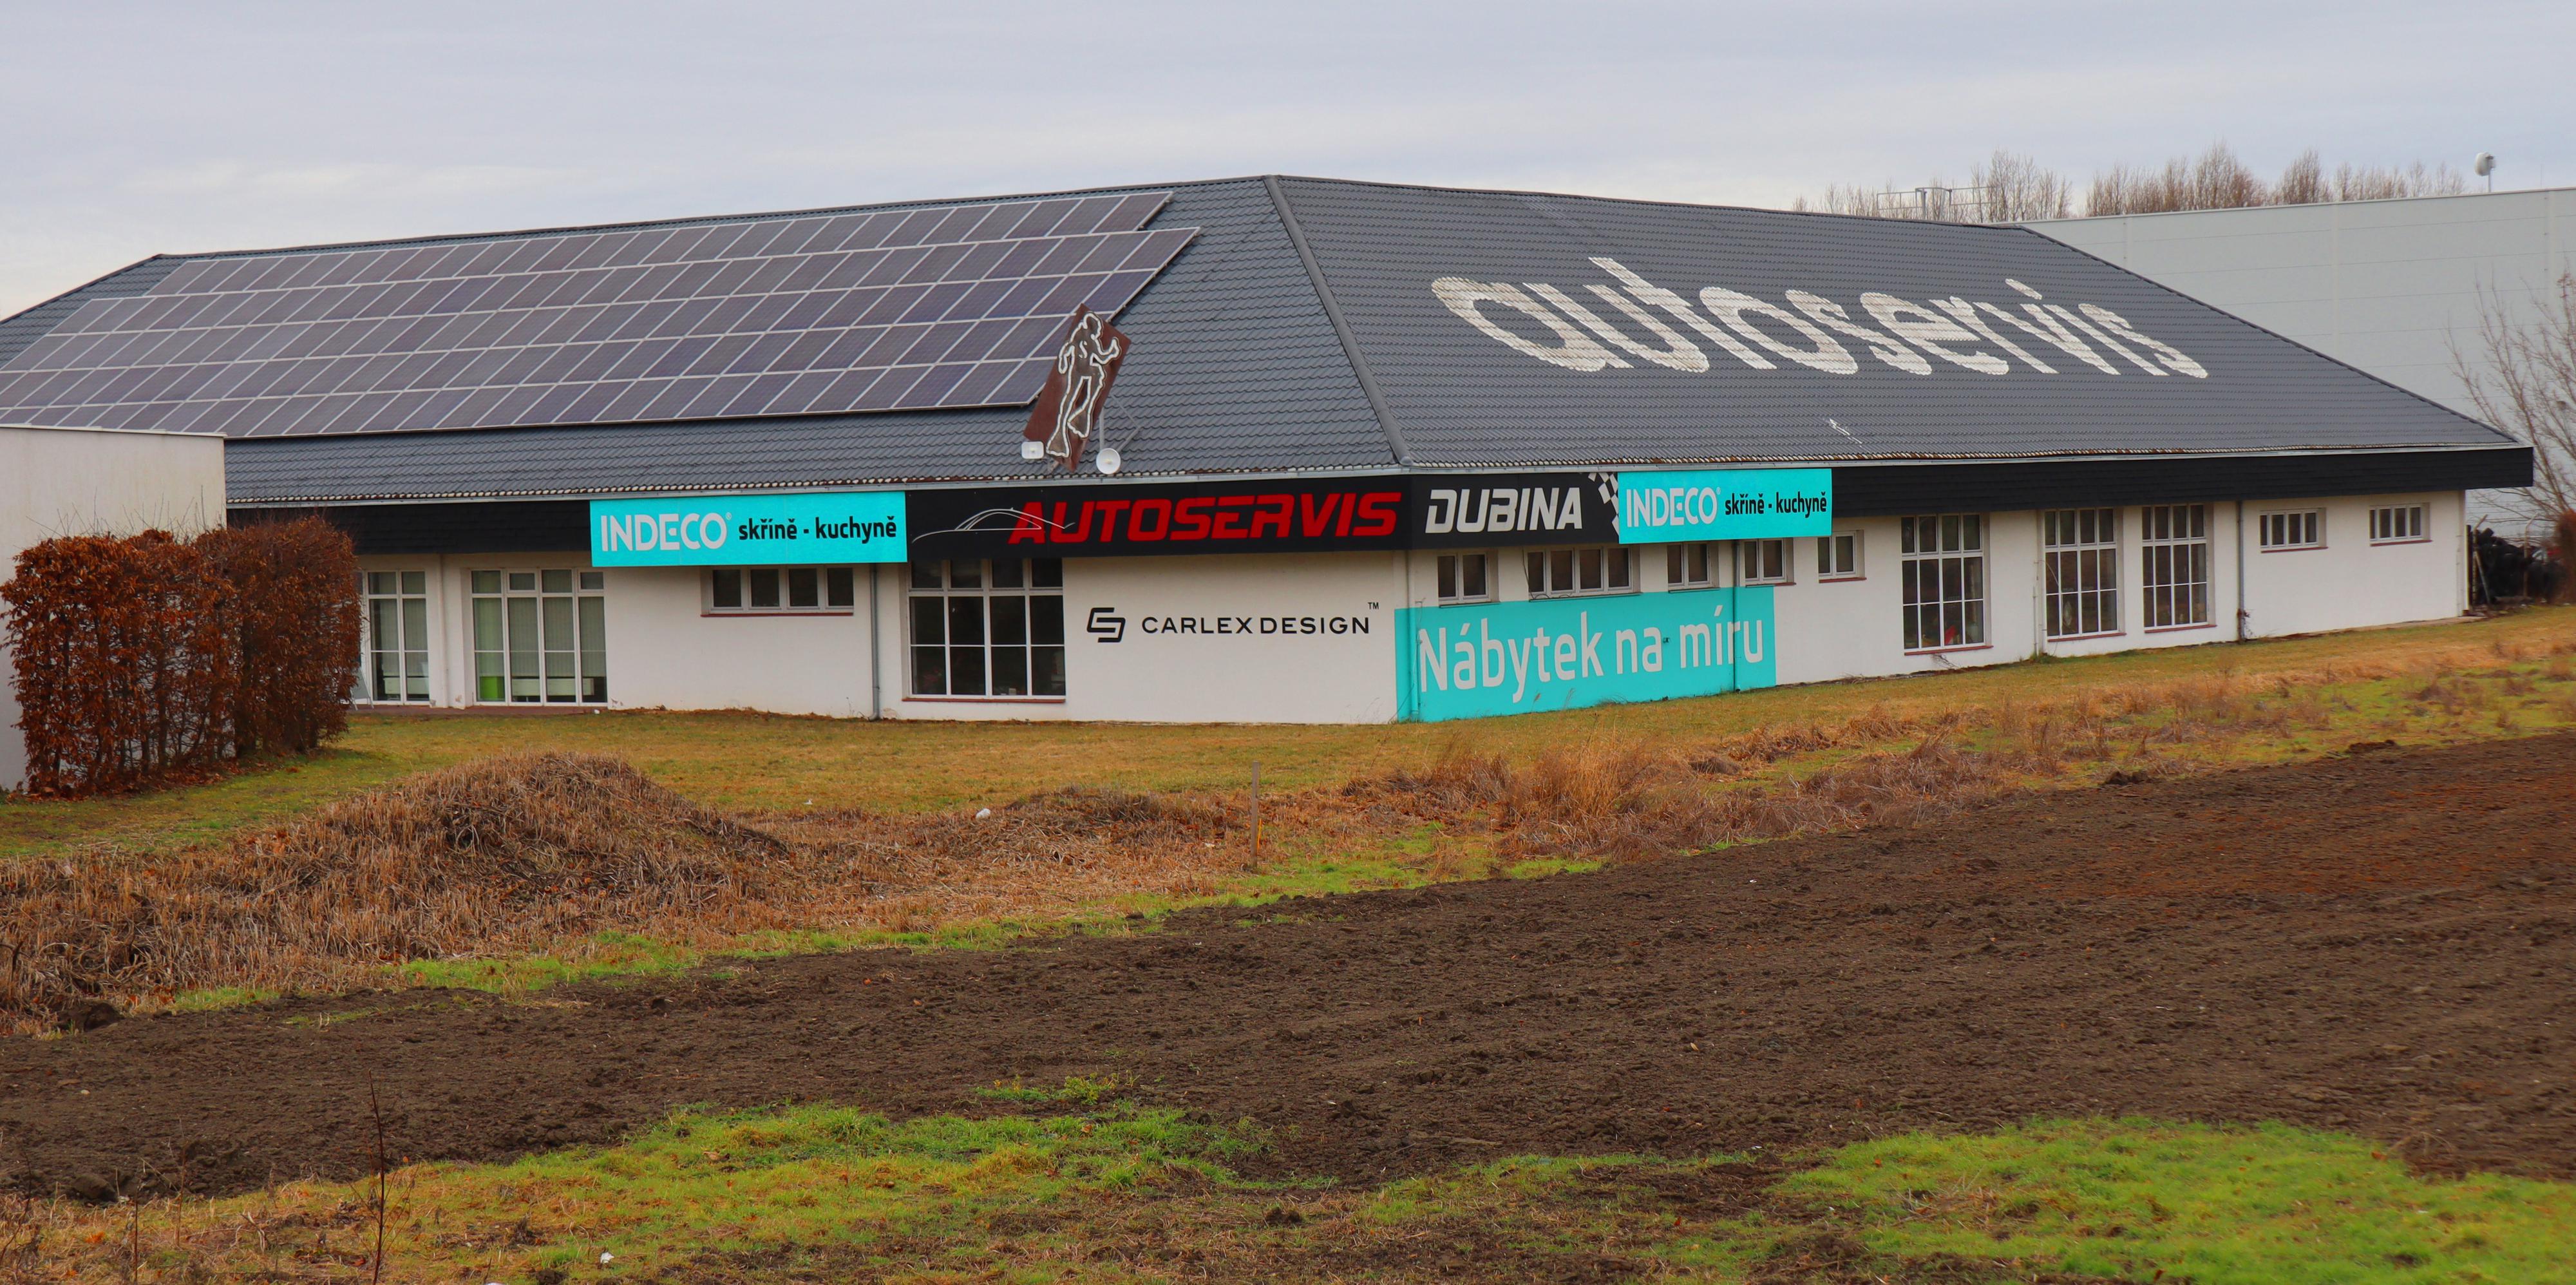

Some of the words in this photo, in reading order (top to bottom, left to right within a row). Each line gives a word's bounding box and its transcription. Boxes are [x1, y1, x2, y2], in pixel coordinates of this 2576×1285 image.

[1432, 256, 2208, 379] autoservis
[1009, 492, 1401, 544] AUTOSERVIS
[1425, 488, 1582, 533] DUBINA
[1725, 492, 1765, 515] skříně
[1776, 490, 1827, 518] kuchyně
[739, 518, 797, 540] skříně
[815, 515, 896, 544] kuchyně
[1142, 616, 1253, 634] CARLEX
[1260, 616, 1369, 634] DESIGN
[1419, 611, 1604, 703] Nábytek
[1616, 627, 1663, 674] na
[1680, 605, 1763, 669] míru
